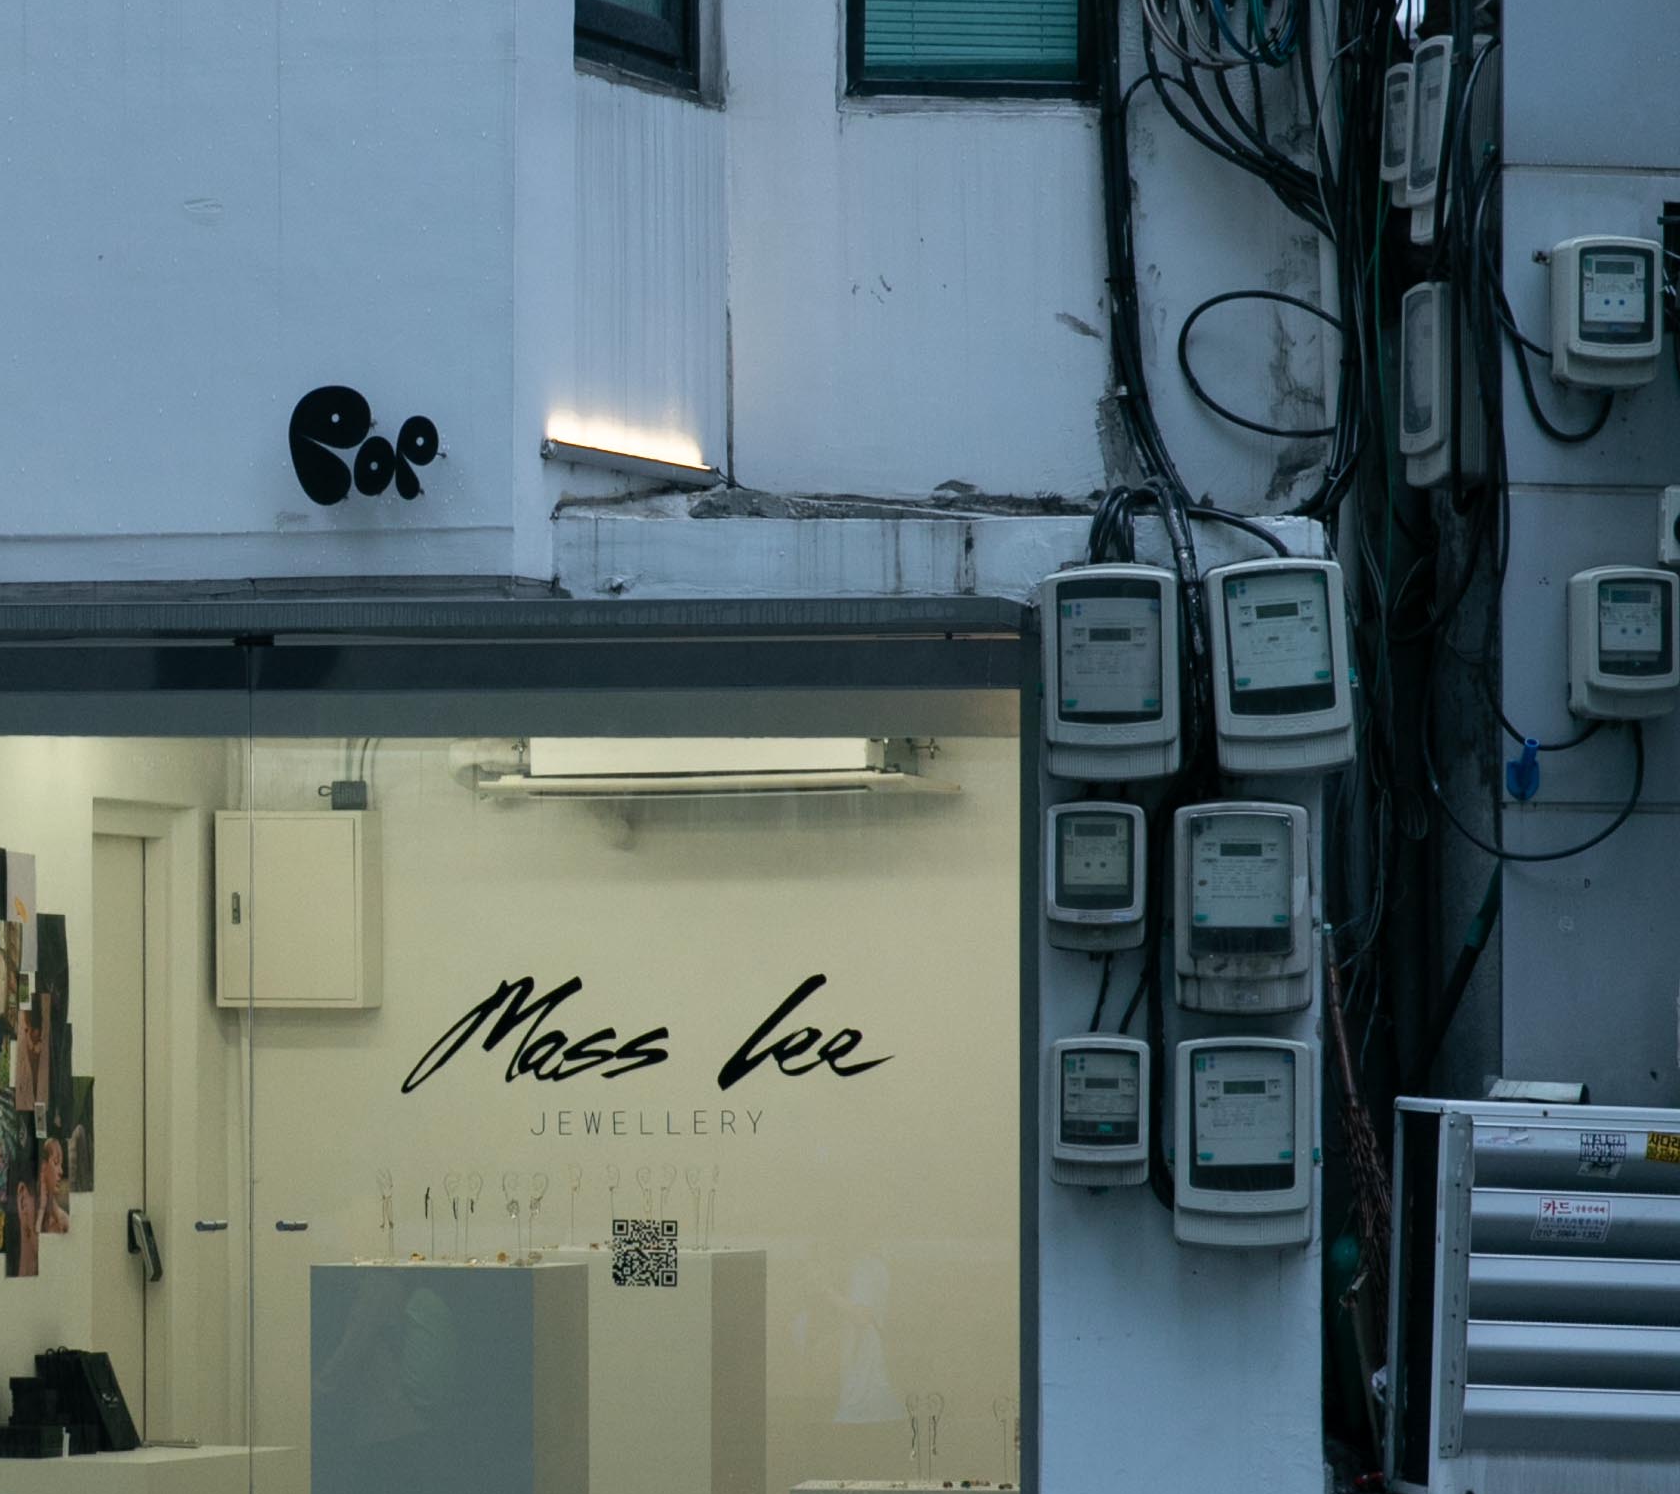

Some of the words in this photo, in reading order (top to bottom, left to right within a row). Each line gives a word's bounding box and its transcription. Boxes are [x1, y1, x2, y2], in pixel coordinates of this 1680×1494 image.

[400, 976, 669, 1095] Mass
[717, 973, 897, 1092] Lee
[530, 1110, 763, 1136] JEWELLERY
[1543, 1200, 1572, 1216] 카드
